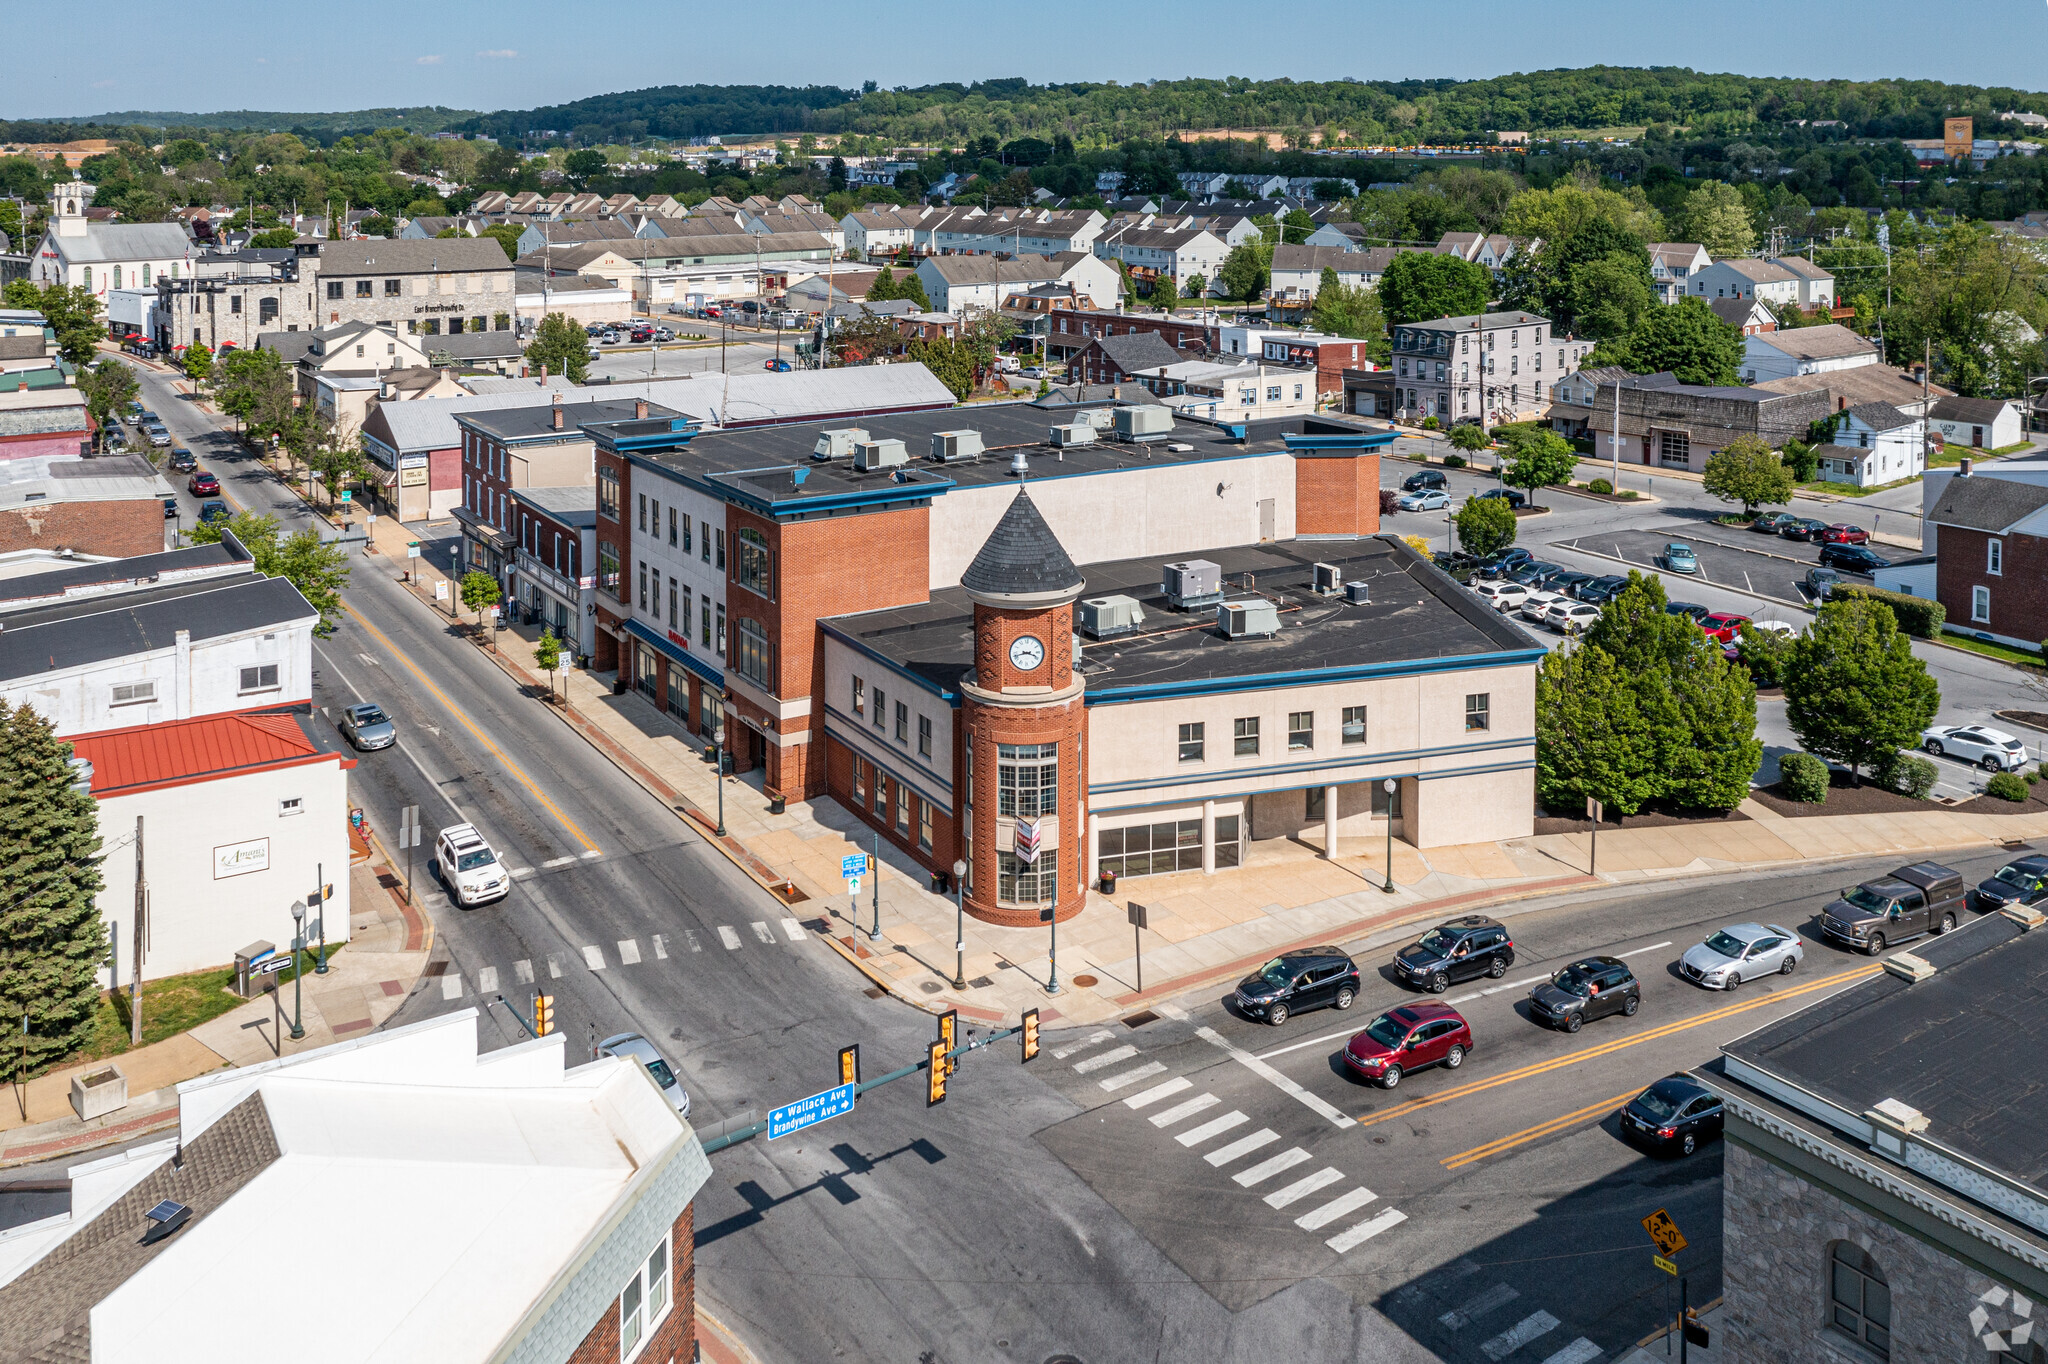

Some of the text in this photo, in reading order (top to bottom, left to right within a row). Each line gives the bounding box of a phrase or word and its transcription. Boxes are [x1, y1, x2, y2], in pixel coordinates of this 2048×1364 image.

[425, 304, 440, 313] Branch
[440, 303, 458, 313] Brewing
[560, 659, 571, 667] 25
[787, 1089, 847, 1117] Wallace Ave
[774, 1105, 837, 1135] Brandywine Ave
[1662, 1261, 1675, 1272] MILE
